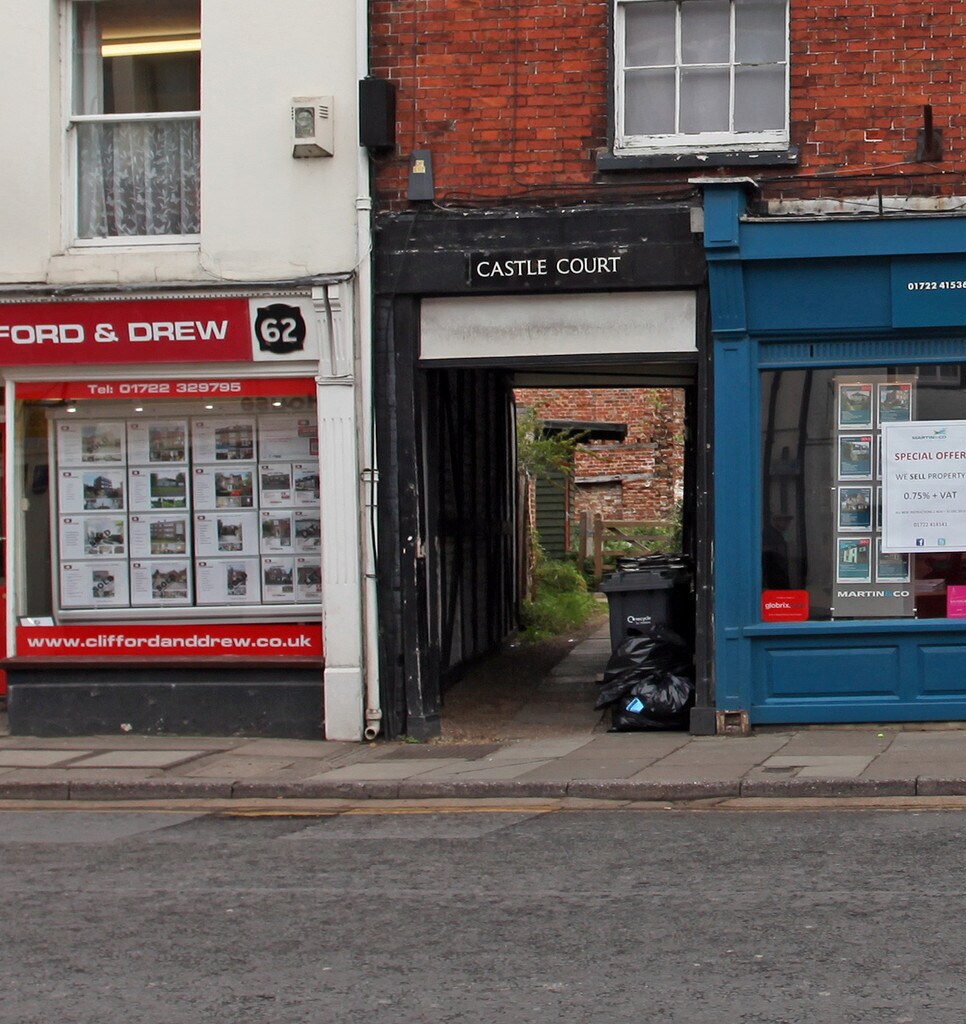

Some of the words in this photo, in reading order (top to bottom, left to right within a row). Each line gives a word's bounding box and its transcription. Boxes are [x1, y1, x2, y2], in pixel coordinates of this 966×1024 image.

[476, 259, 548, 277] CASTLE
[556, 256, 621, 274] COURT
[907, 281, 937, 290] 01722
[94, 323, 119, 343] &
[128, 320, 229, 342] DREW
[260, 317, 298, 343] 62
[87, 384, 114, 395] Tel:
[119, 383, 170, 394] 01722
[176, 382, 242, 393] 329795
[894, 452, 933, 461] SPECIAL
[935, 451, 966, 460] OFFER
[903, 492, 930, 500] 0.75%
[939, 491, 957, 499] VAT
[27, 634, 312, 648] www.cliffordanddrew.co.uk
